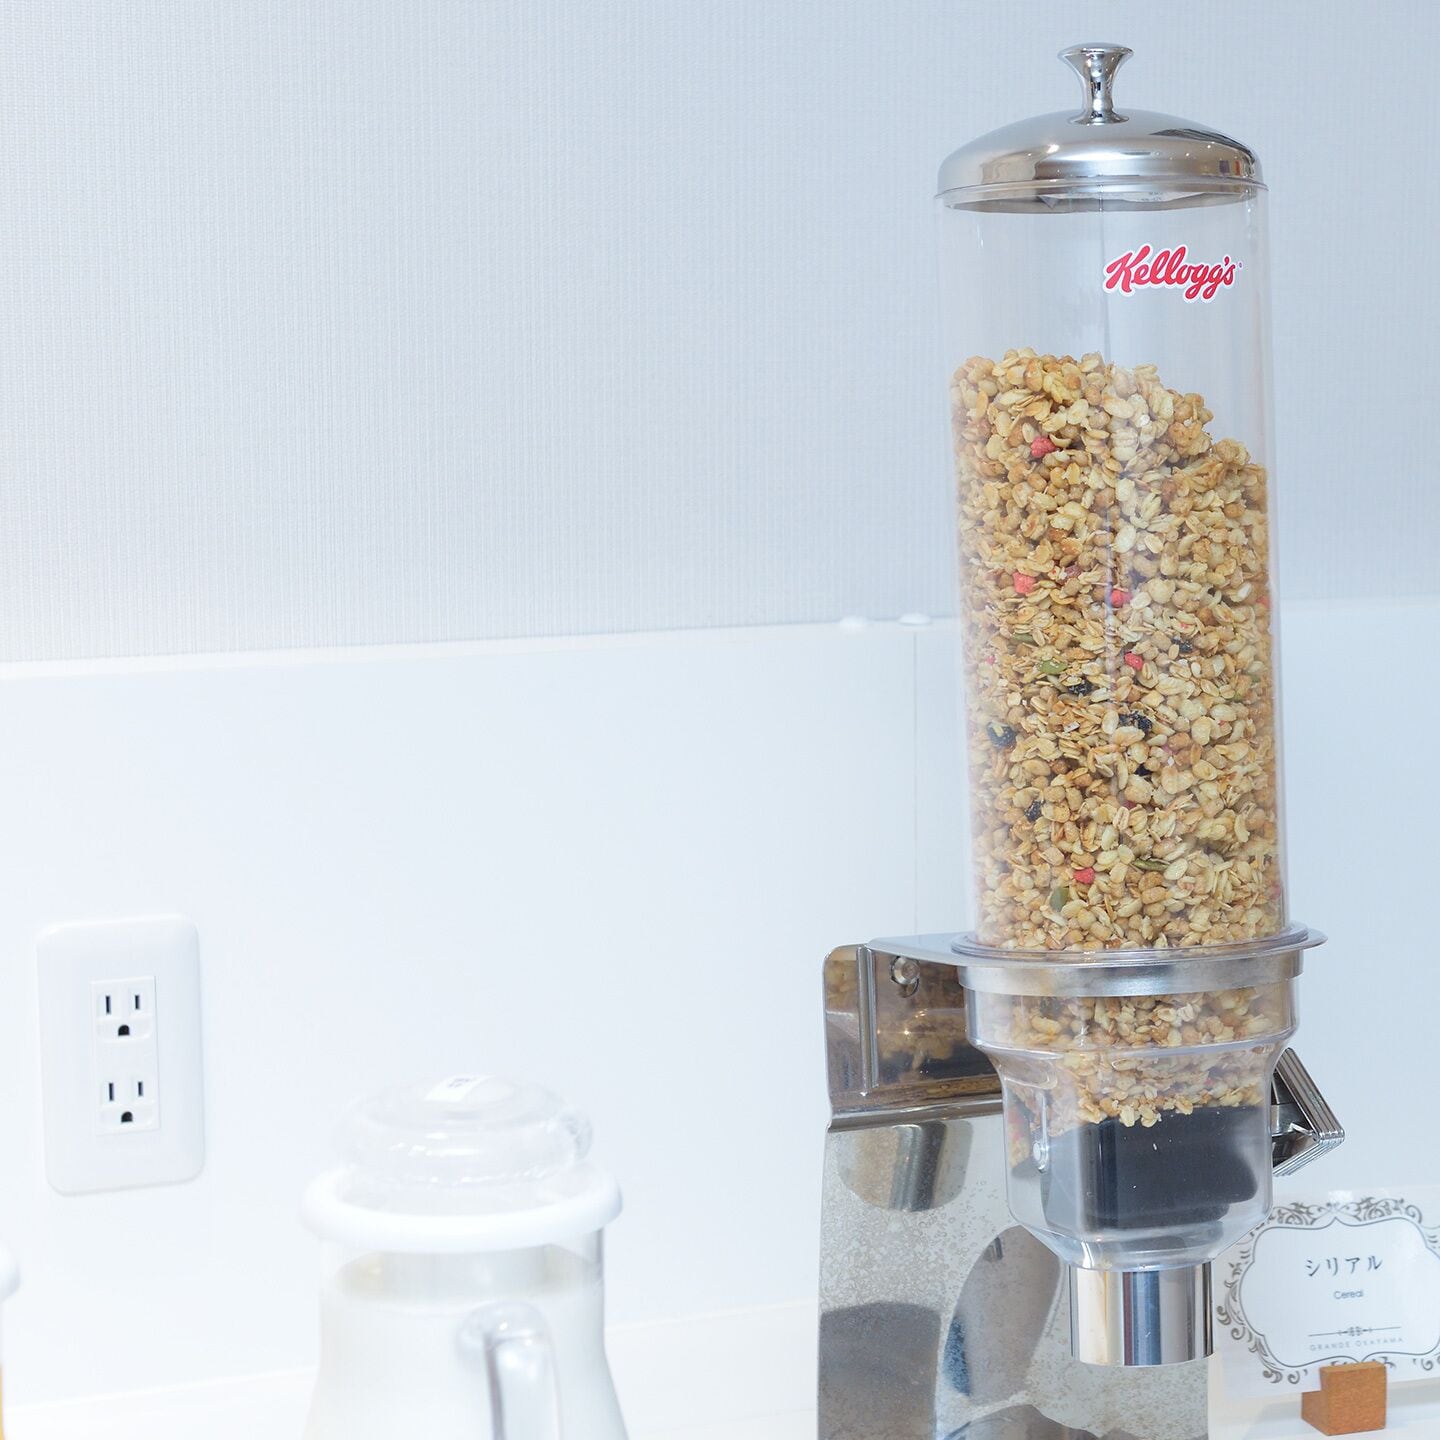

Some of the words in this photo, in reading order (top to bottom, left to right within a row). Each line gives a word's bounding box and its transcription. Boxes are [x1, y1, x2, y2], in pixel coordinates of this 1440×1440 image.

[1104, 245, 1236, 300] Kellogg's
[1306, 1255, 1383, 1277] シリアル
[1333, 1289, 1364, 1300] Cereal
